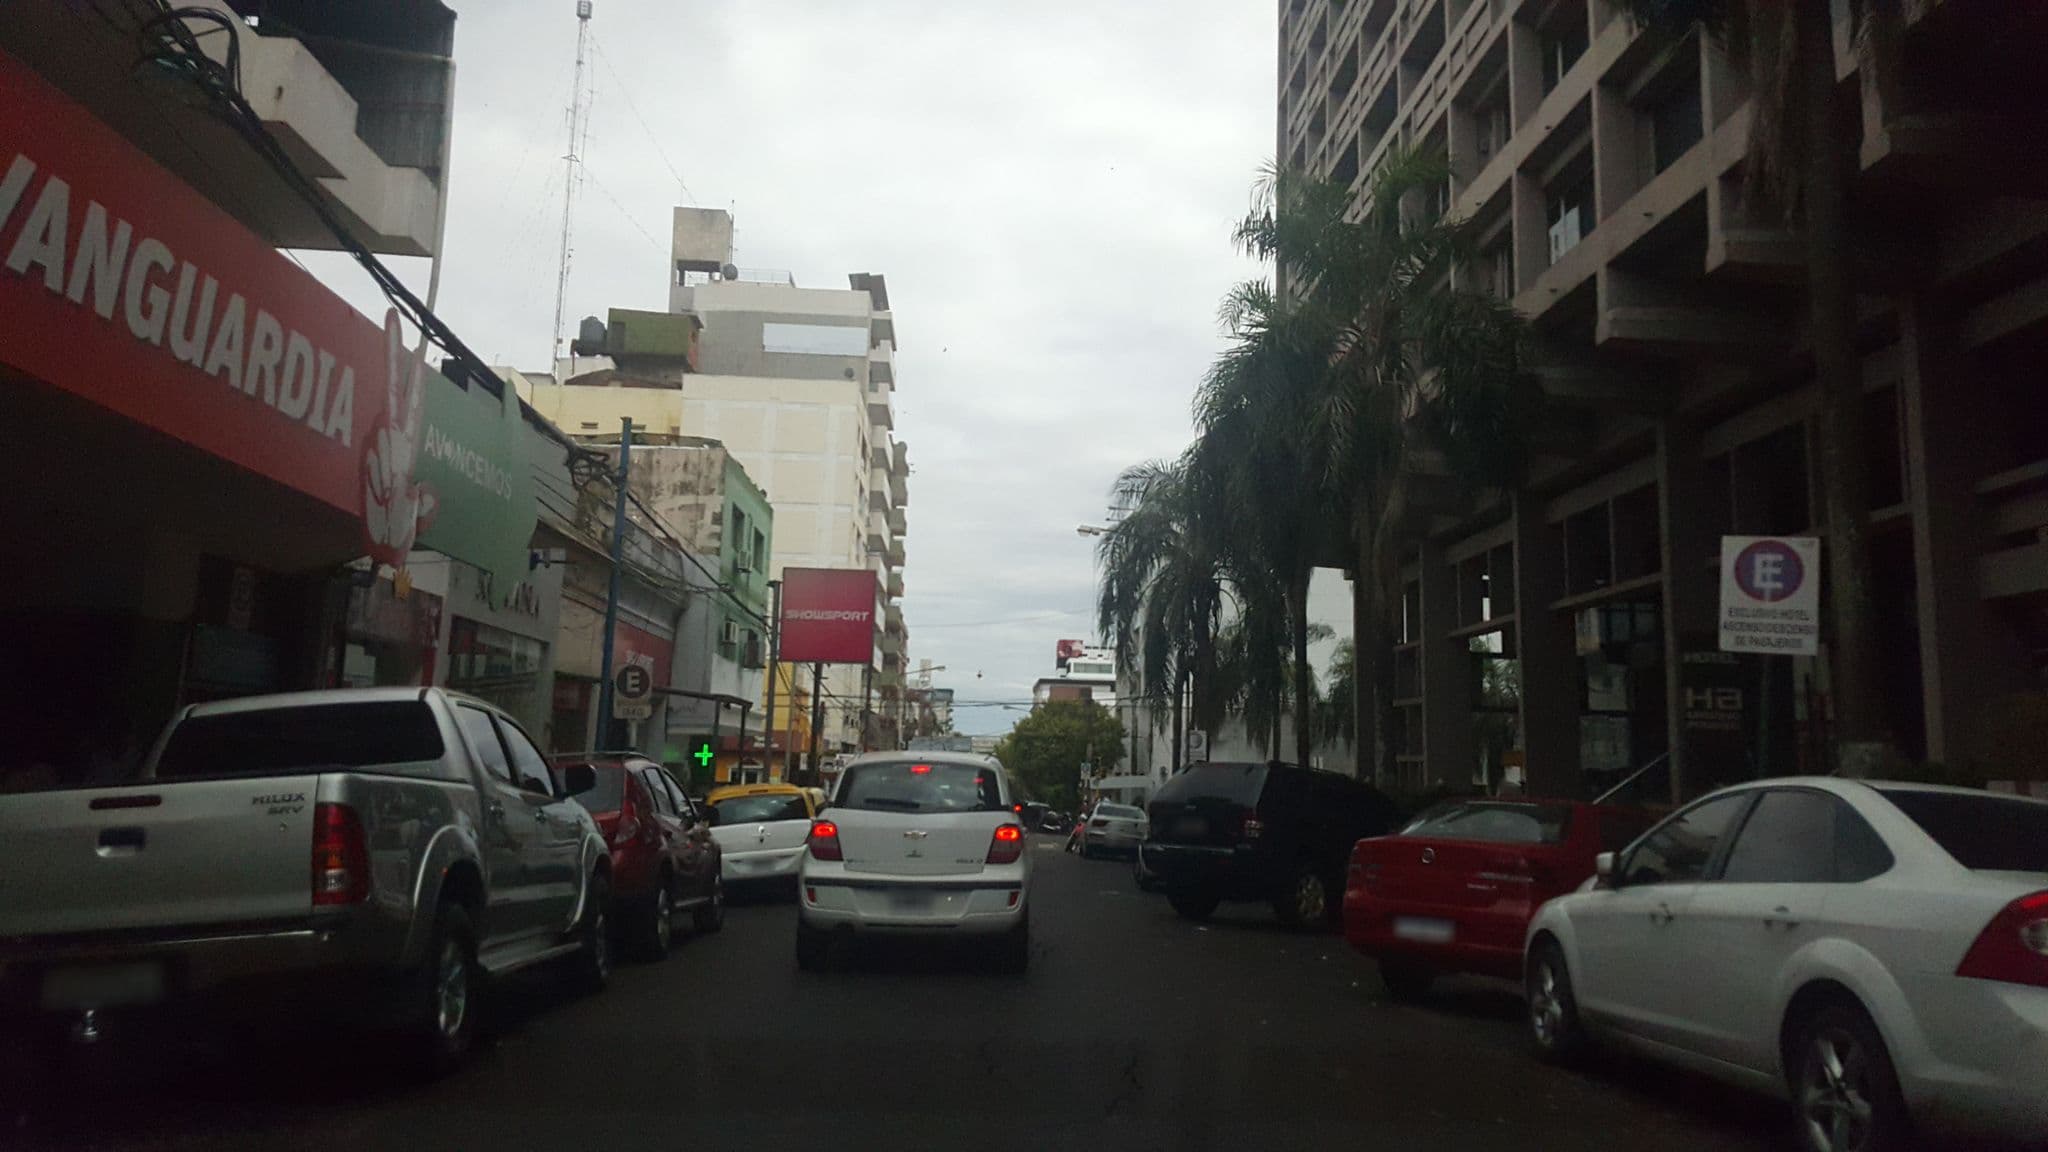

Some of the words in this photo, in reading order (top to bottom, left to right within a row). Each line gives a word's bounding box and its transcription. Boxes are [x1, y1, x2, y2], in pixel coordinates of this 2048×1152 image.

[784, 609, 870, 622] SHOWSPORT
[626, 671, 641, 692] E
[252, 793, 305, 805] HILUX
